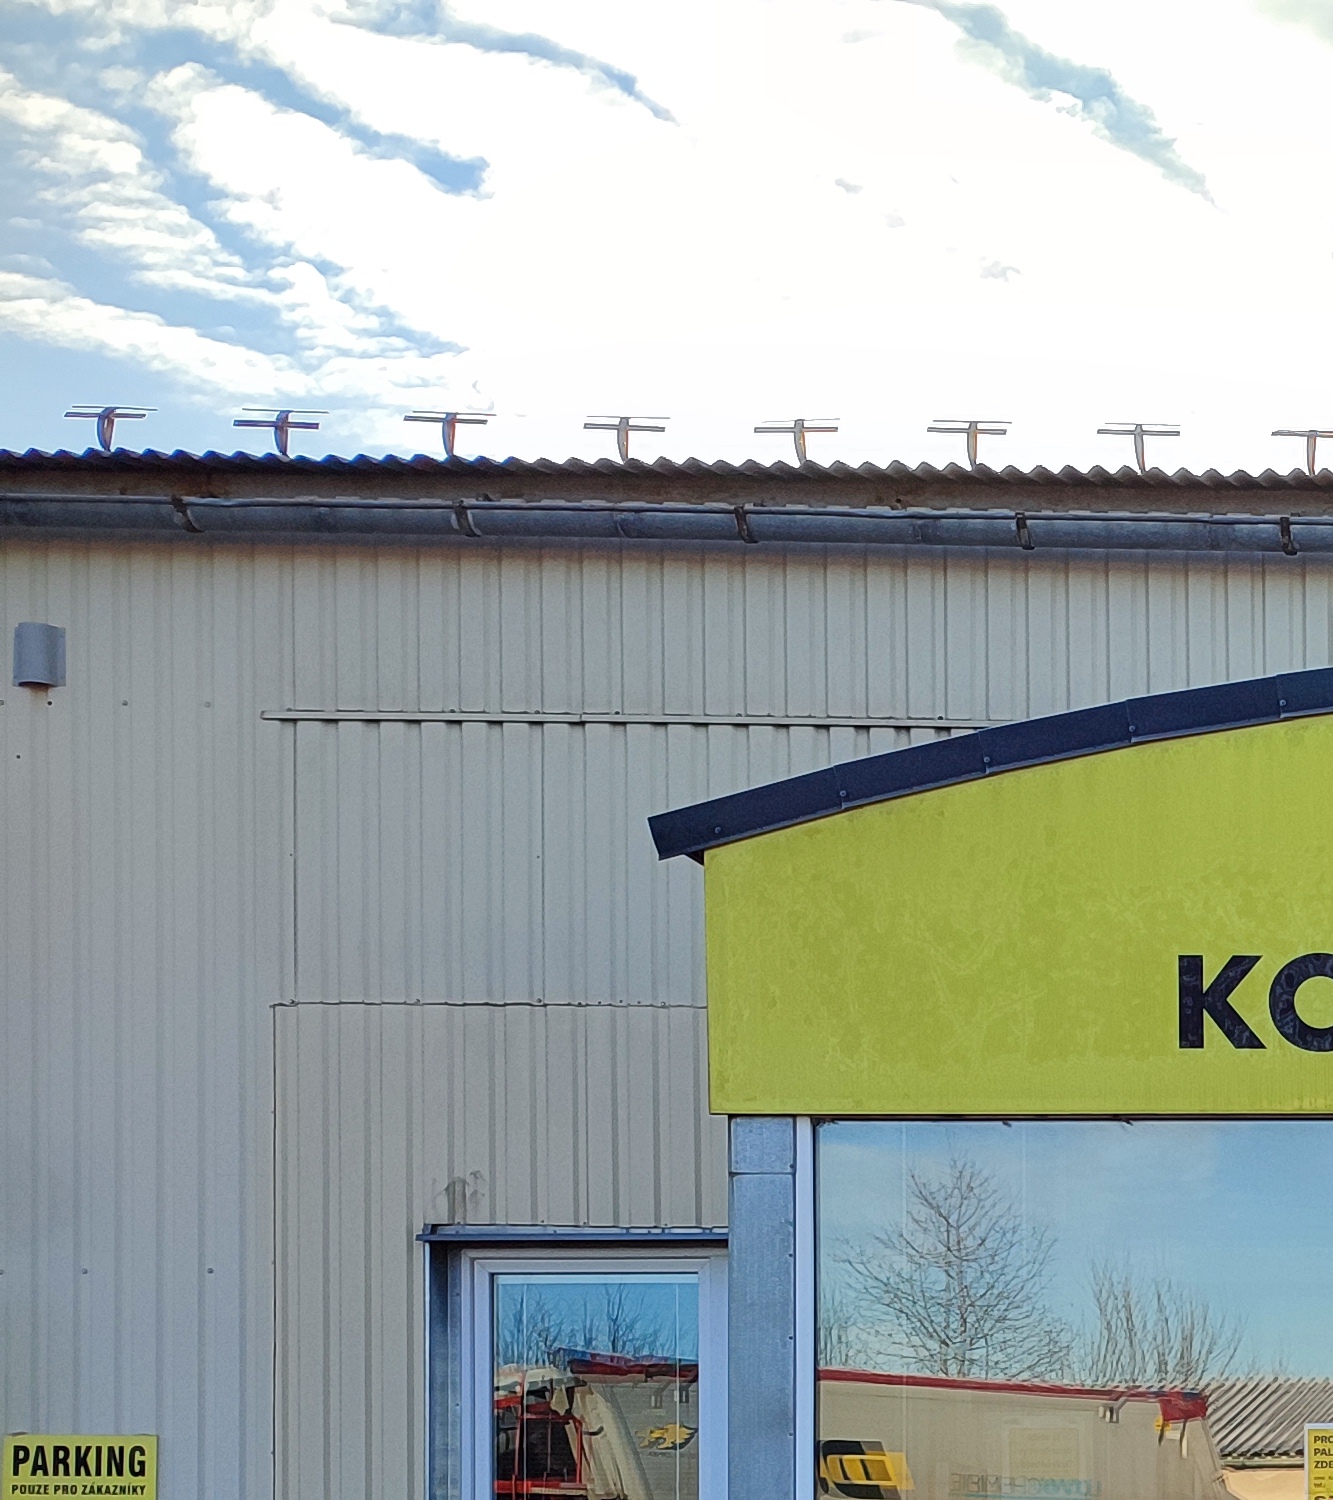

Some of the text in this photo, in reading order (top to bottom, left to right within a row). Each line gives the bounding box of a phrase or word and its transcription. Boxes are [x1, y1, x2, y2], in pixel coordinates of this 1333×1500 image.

[12, 1444, 147, 1477] PARKING
[11, 1482, 146, 1495] POUZE PRO ZÁKAZNÍKY
